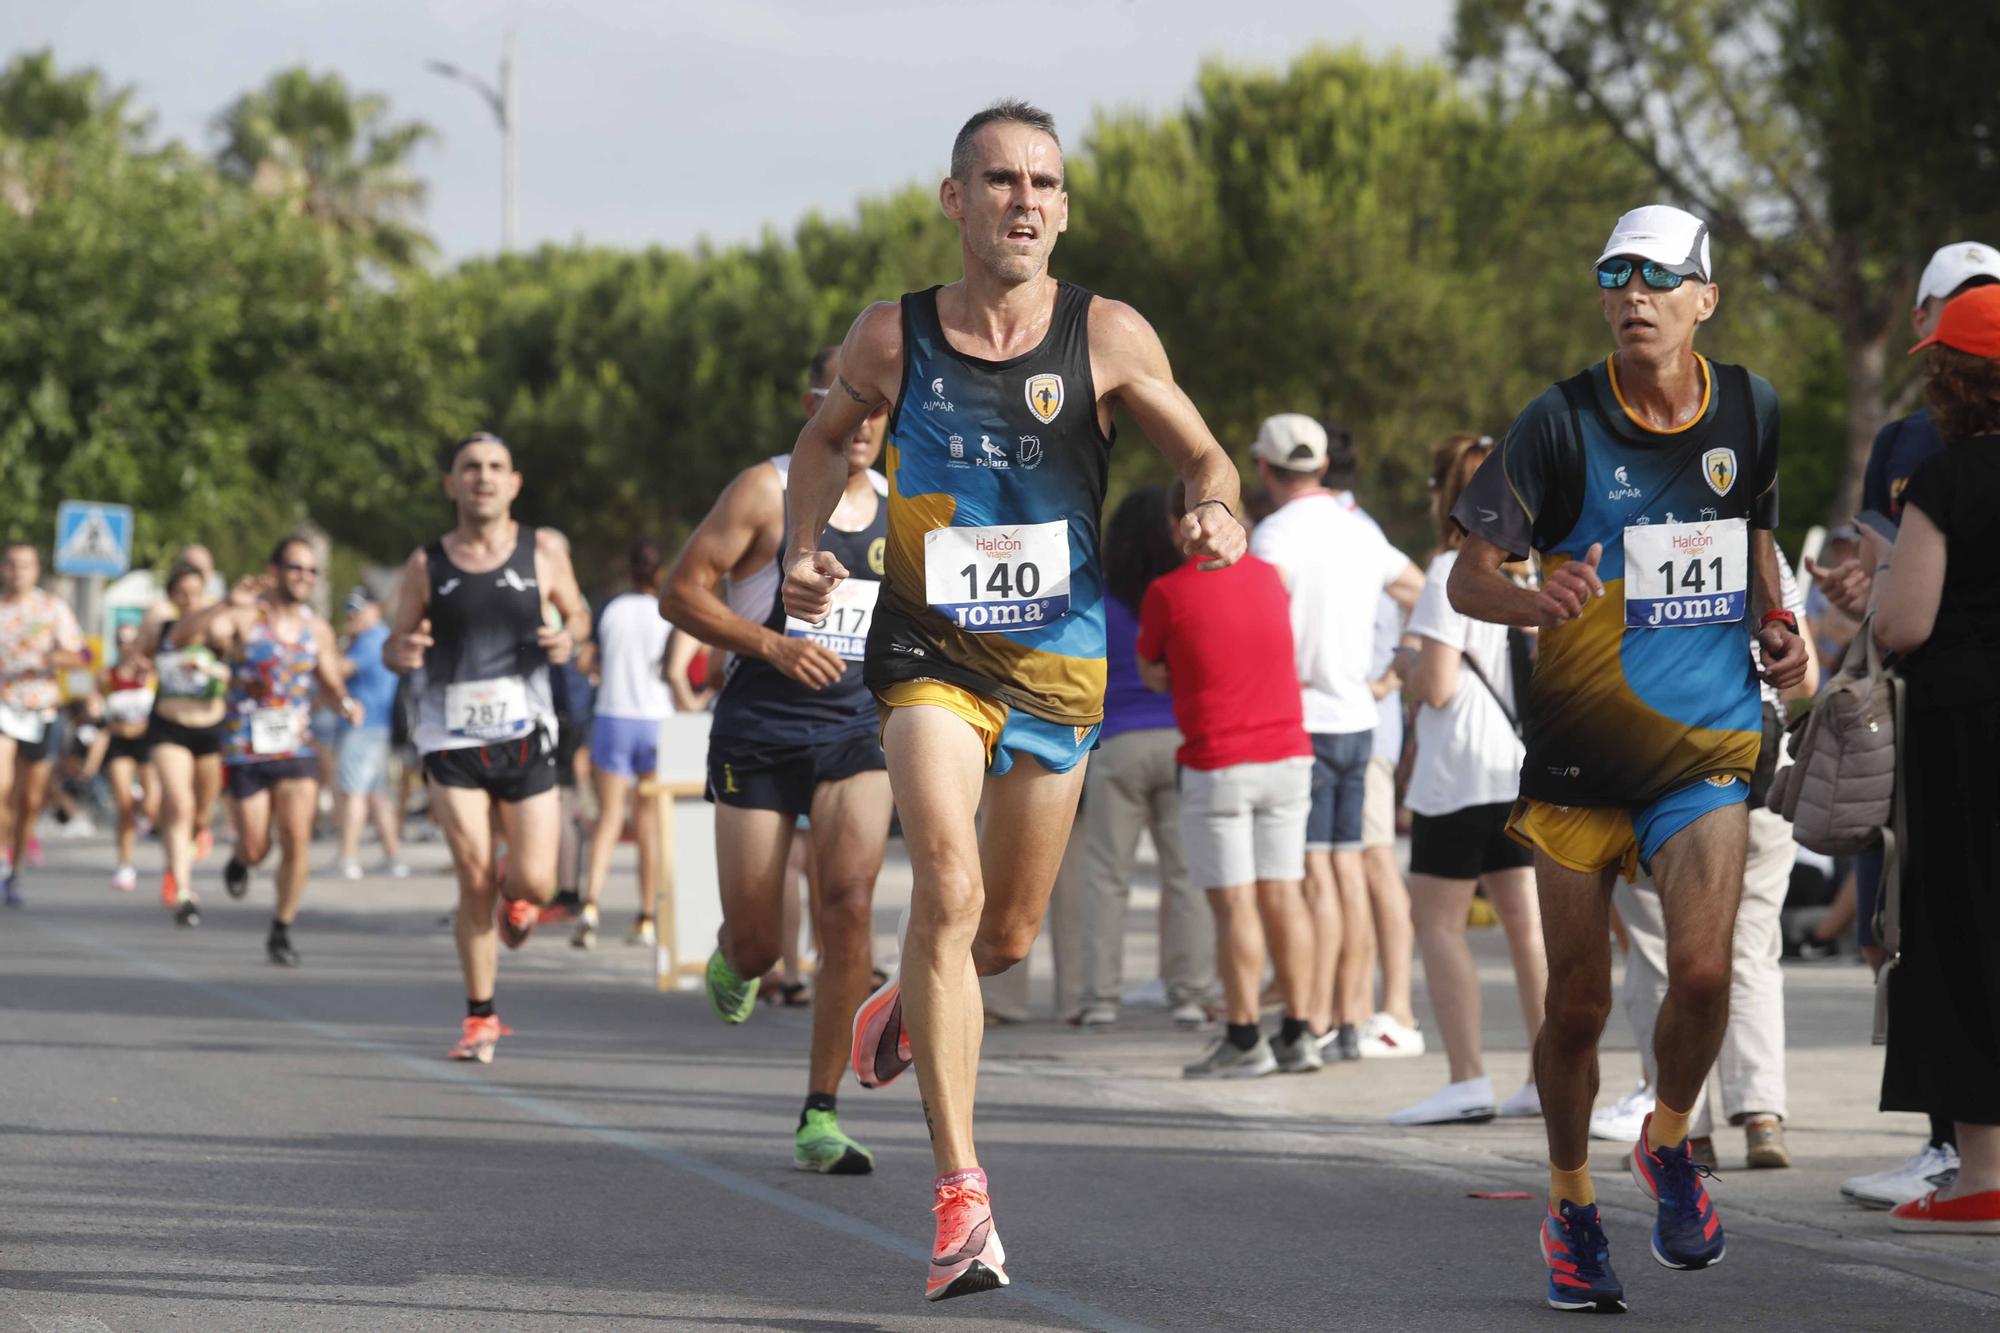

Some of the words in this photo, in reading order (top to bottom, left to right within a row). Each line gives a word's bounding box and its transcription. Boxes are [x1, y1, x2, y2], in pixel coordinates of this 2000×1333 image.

[960, 562, 1040, 600] 140
[1657, 556, 1723, 596] 141
[464, 701, 508, 727] 287
